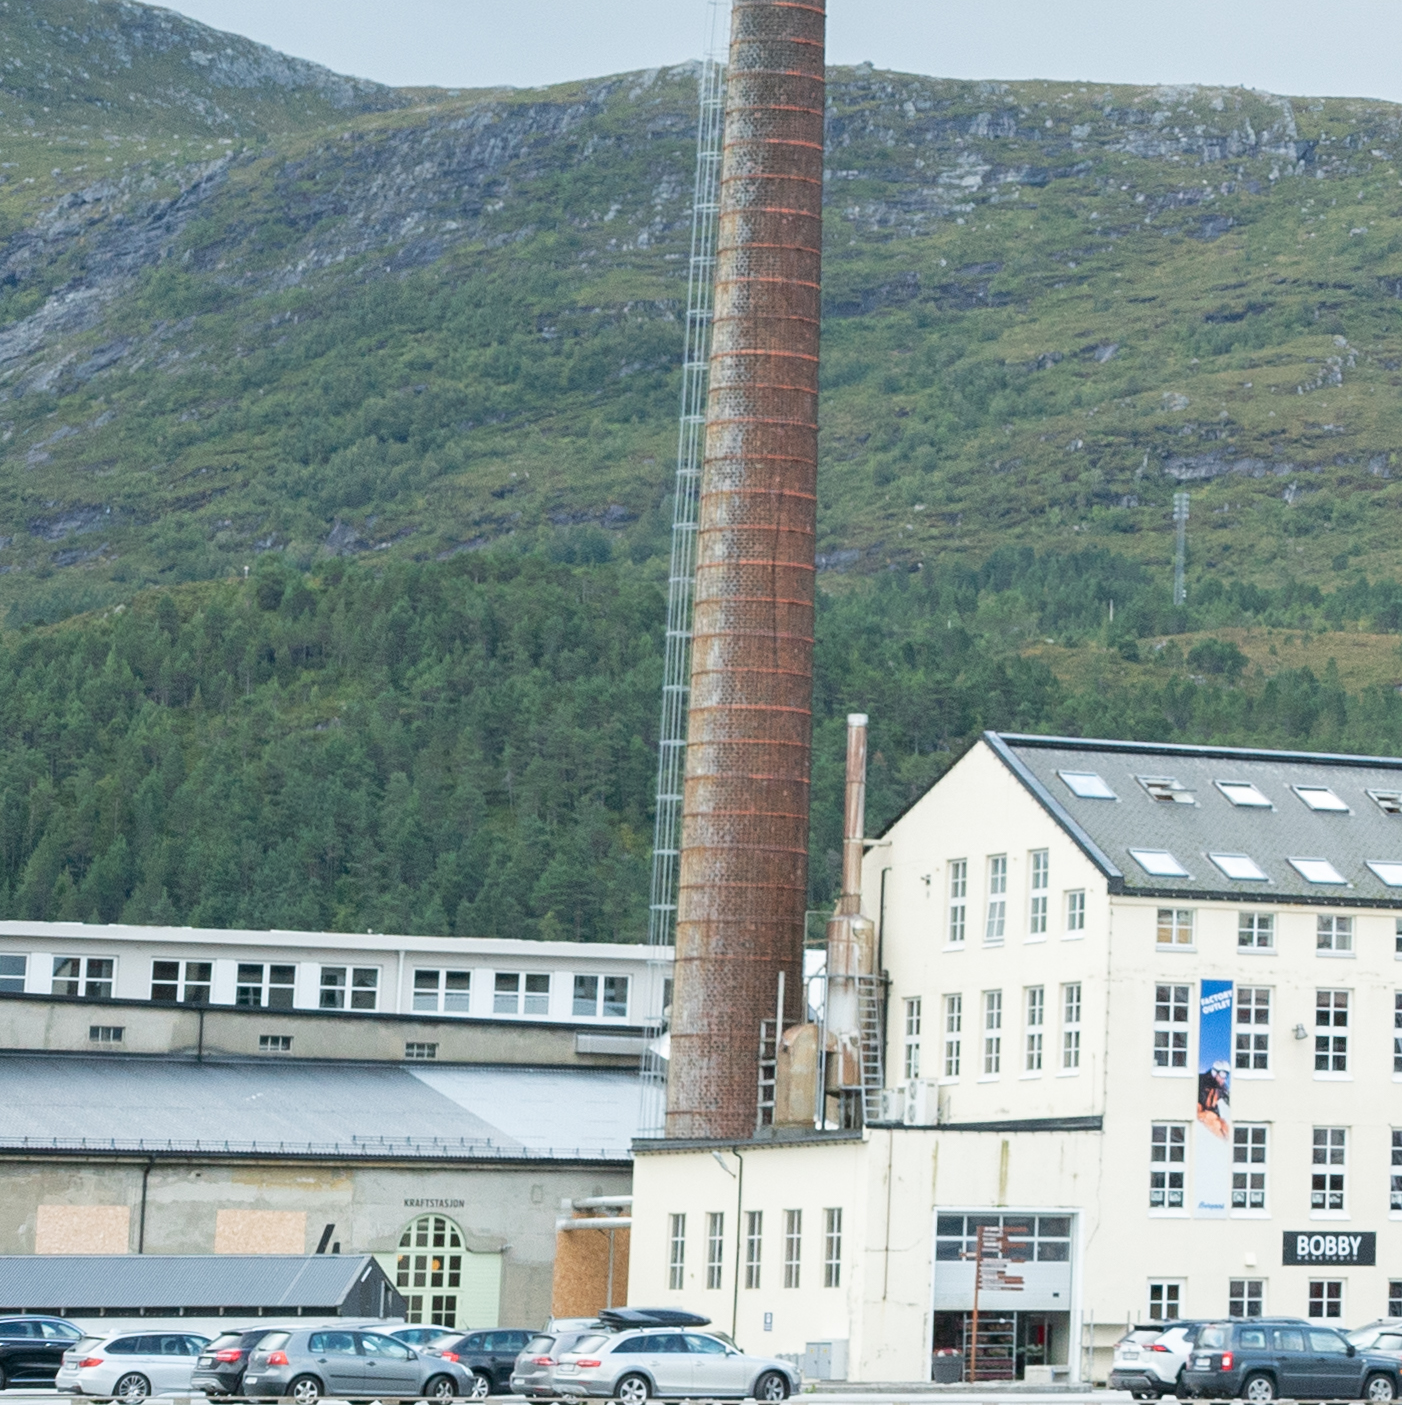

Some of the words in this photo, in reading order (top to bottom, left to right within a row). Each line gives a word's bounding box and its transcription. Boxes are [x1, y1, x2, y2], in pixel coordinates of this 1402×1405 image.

[1201, 990, 1232, 1006] FACTORY
[1202, 999, 1230, 1014] OUTLET
[404, 1199, 465, 1208] KRAFTSTASJON
[1297, 1235, 1362, 1256] BOBBY
